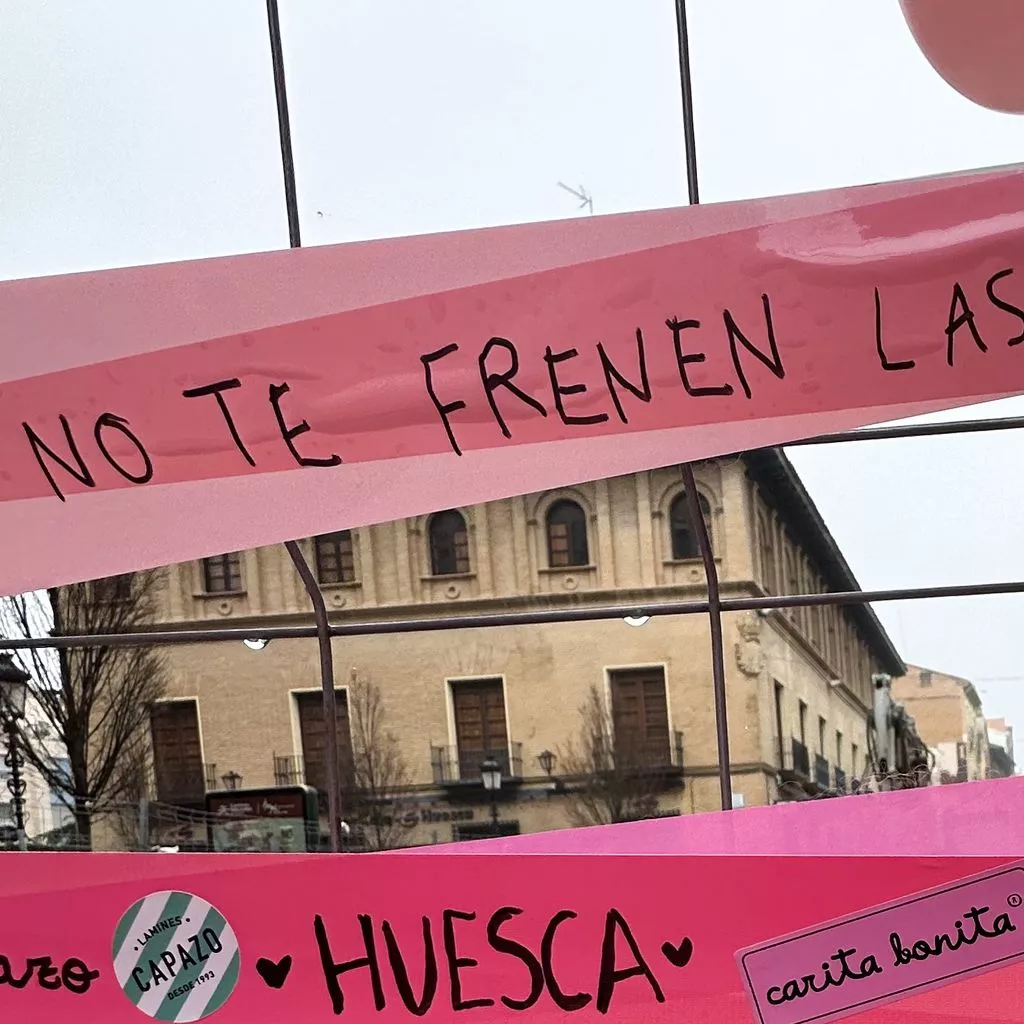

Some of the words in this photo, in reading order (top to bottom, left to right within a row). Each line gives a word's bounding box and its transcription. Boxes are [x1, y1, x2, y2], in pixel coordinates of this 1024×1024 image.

[22, 413, 153, 502] NO
[183, 379, 342, 467] TE
[420, 294, 785, 456] FRENEN
[132, 928, 223, 992] CAPAZO
[137, 916, 183, 947] LAMINES
[314, 906, 666, 1016] HUESCA
[167, 980, 195, 1001] DESDE
[195, 970, 215, 986] 1993
[766, 948, 883, 1005] carita
